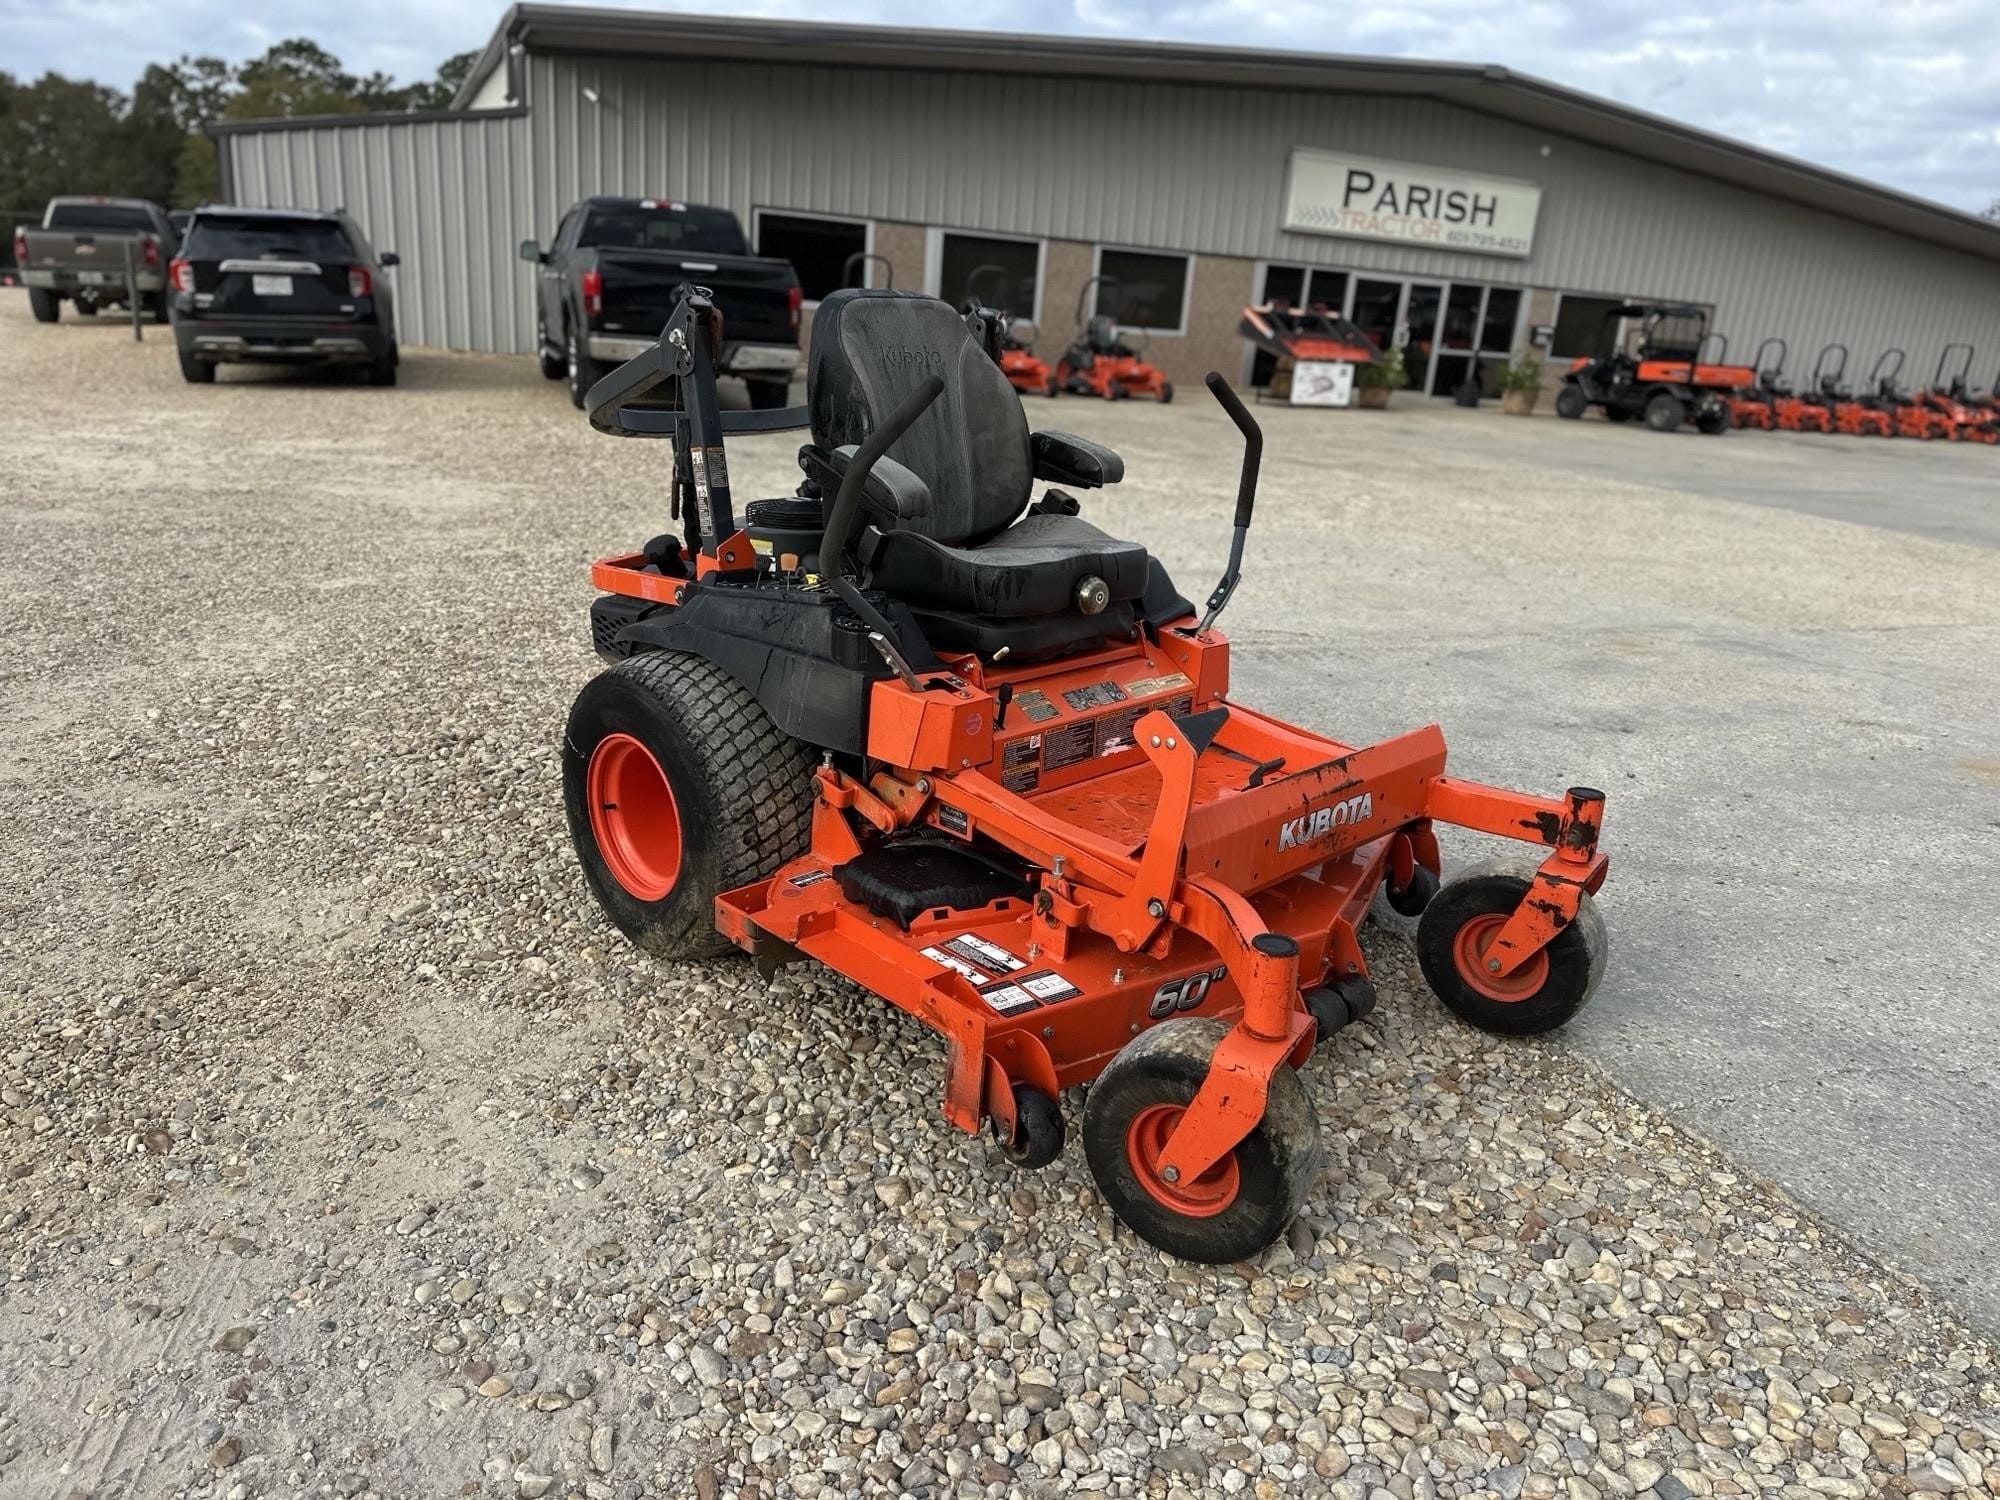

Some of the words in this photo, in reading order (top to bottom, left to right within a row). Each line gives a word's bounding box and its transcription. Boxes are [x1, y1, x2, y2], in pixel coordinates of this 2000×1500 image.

[1339, 208, 1443, 241] TRACTOR
[1343, 168, 1498, 227] PARISH
[1278, 792, 1373, 853] KUBOTA
[1149, 965, 1228, 1020] 60"
